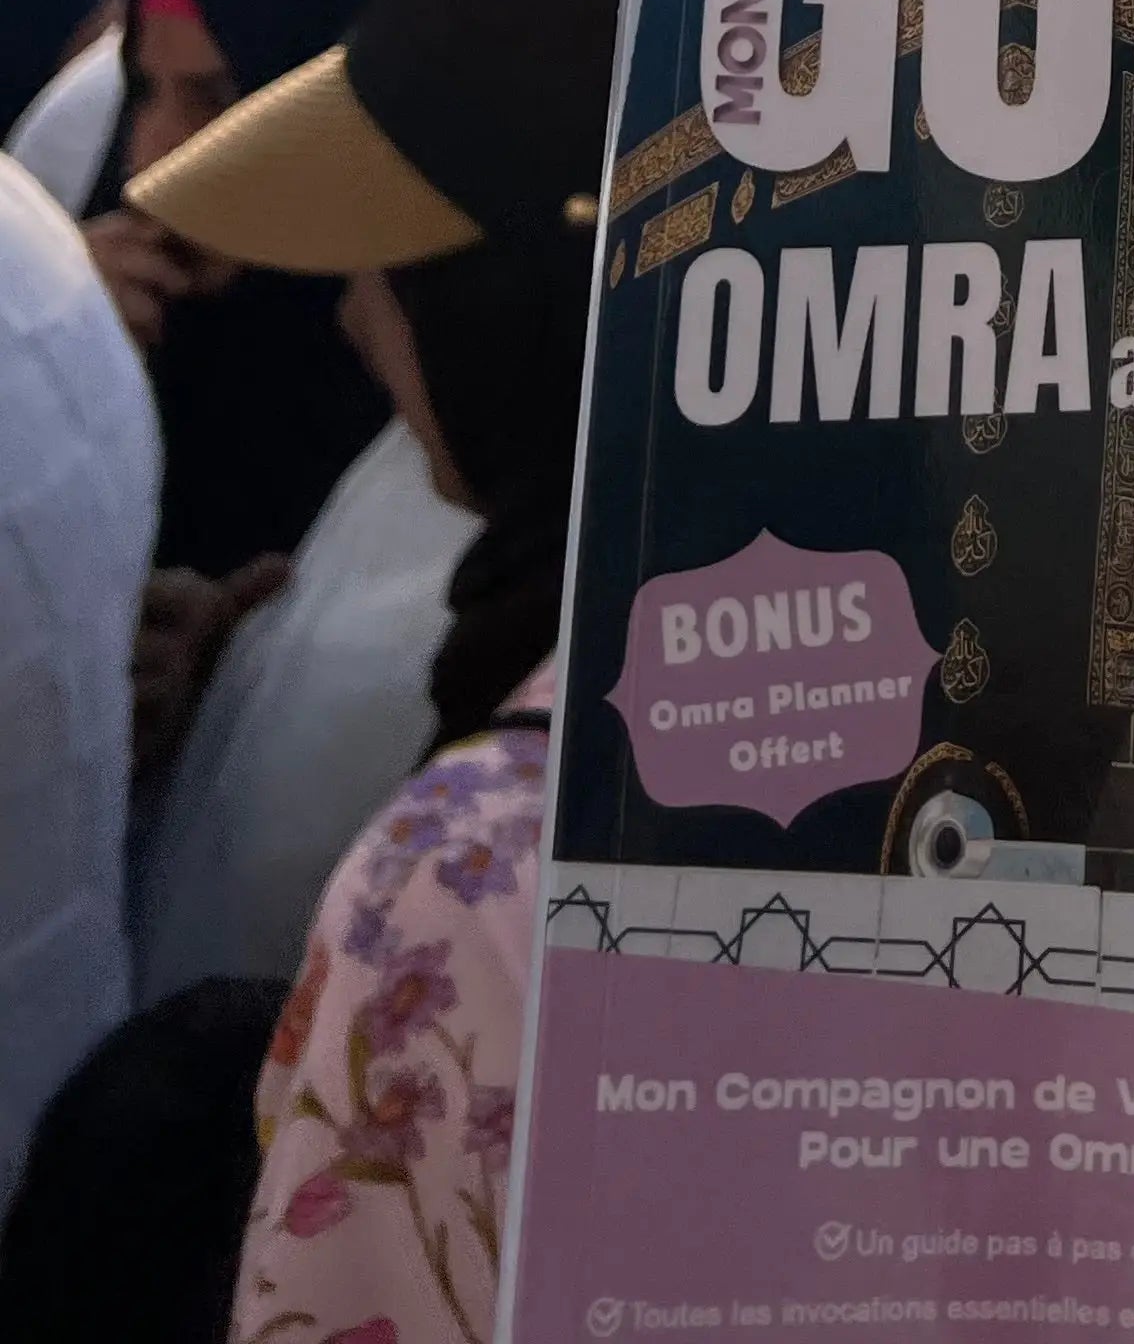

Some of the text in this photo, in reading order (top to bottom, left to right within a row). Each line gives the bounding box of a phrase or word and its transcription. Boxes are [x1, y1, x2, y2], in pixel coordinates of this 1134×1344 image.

[674, 238, 1092, 426] OMRA
[660, 581, 872, 665] BONUS
[650, 676, 912, 730] Omra Planner
[729, 731, 844, 771] Offert
[596, 1074, 697, 1112] Mon
[716, 1072, 1016, 1121] Compagnon
[1033, 1075, 1097, 1112] de
[800, 1131, 918, 1168] Pour
[938, 1136, 1031, 1168] une
[856, 1229, 894, 1256] Un
[902, 1228, 979, 1262] guide
[988, 1233, 1037, 1261] pas
[1047, 1229, 1063, 1257] à
[1072, 1237, 1121, 1265] pas
[633, 1300, 722, 1330] Toutes
[731, 1299, 773, 1327] les
[782, 1296, 937, 1326] invocations
[947, 1296, 1110, 1328] essentielles
